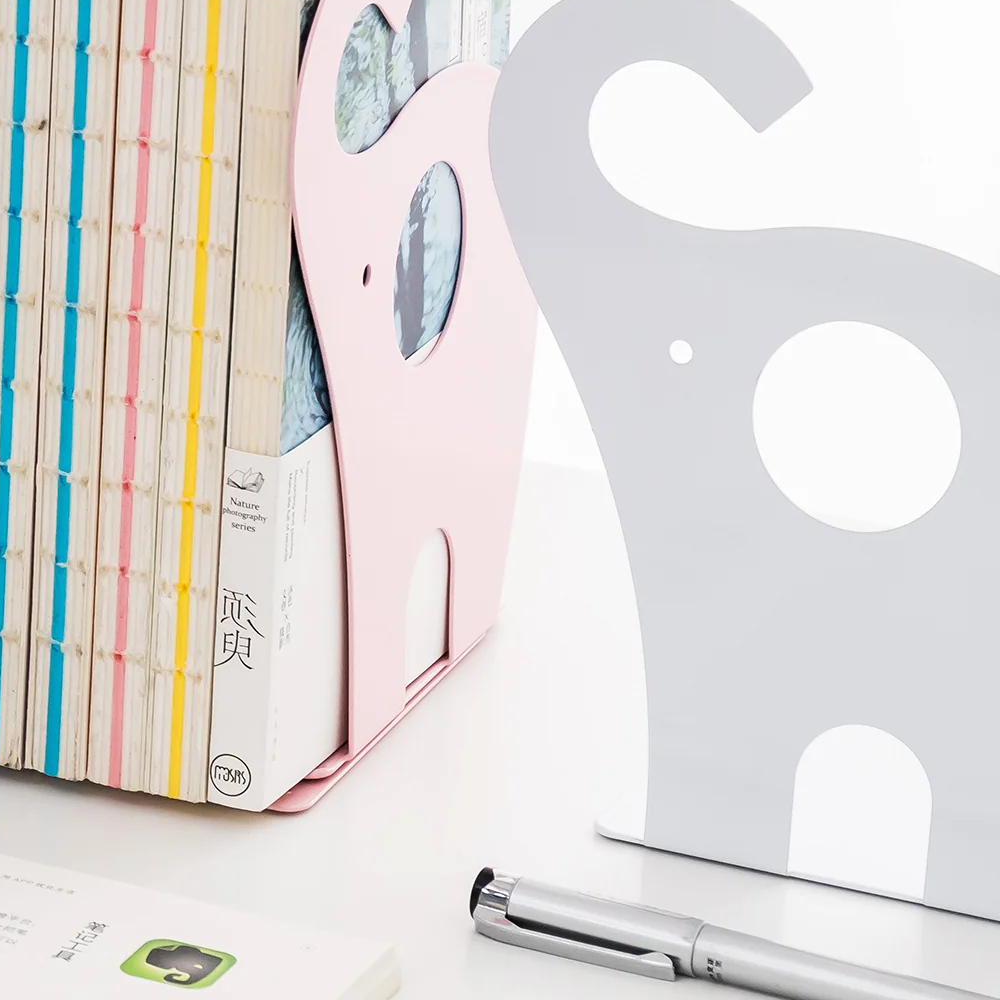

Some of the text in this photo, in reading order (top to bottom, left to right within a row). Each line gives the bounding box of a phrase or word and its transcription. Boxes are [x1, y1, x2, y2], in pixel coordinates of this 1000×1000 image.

[230, 496, 260, 511] Nature
[222, 507, 267, 524] photography
[231, 521, 256, 533] series
